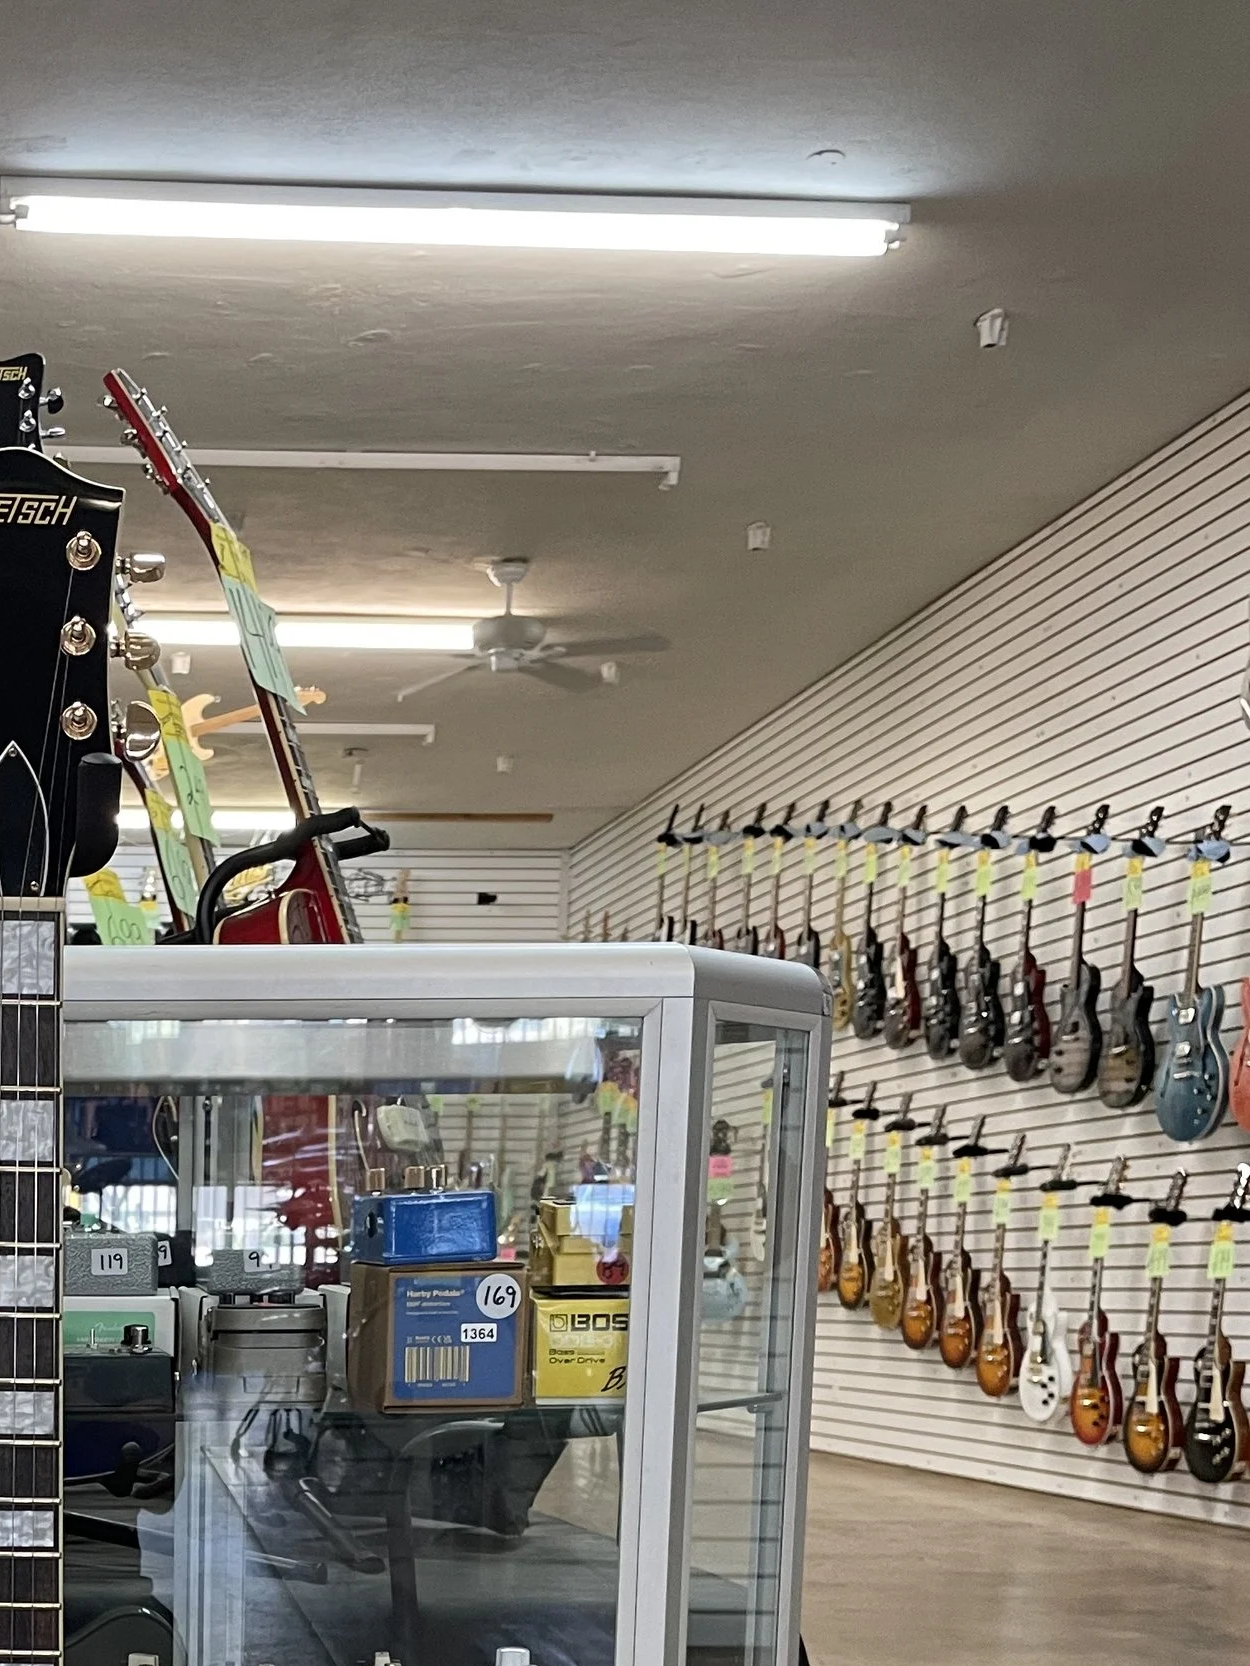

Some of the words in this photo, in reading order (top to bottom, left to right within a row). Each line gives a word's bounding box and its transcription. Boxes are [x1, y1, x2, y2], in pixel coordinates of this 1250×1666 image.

[99, 1252, 124, 1271] 119
[483, 1285, 517, 1308] 169
[462, 1328, 495, 1340] 1364
